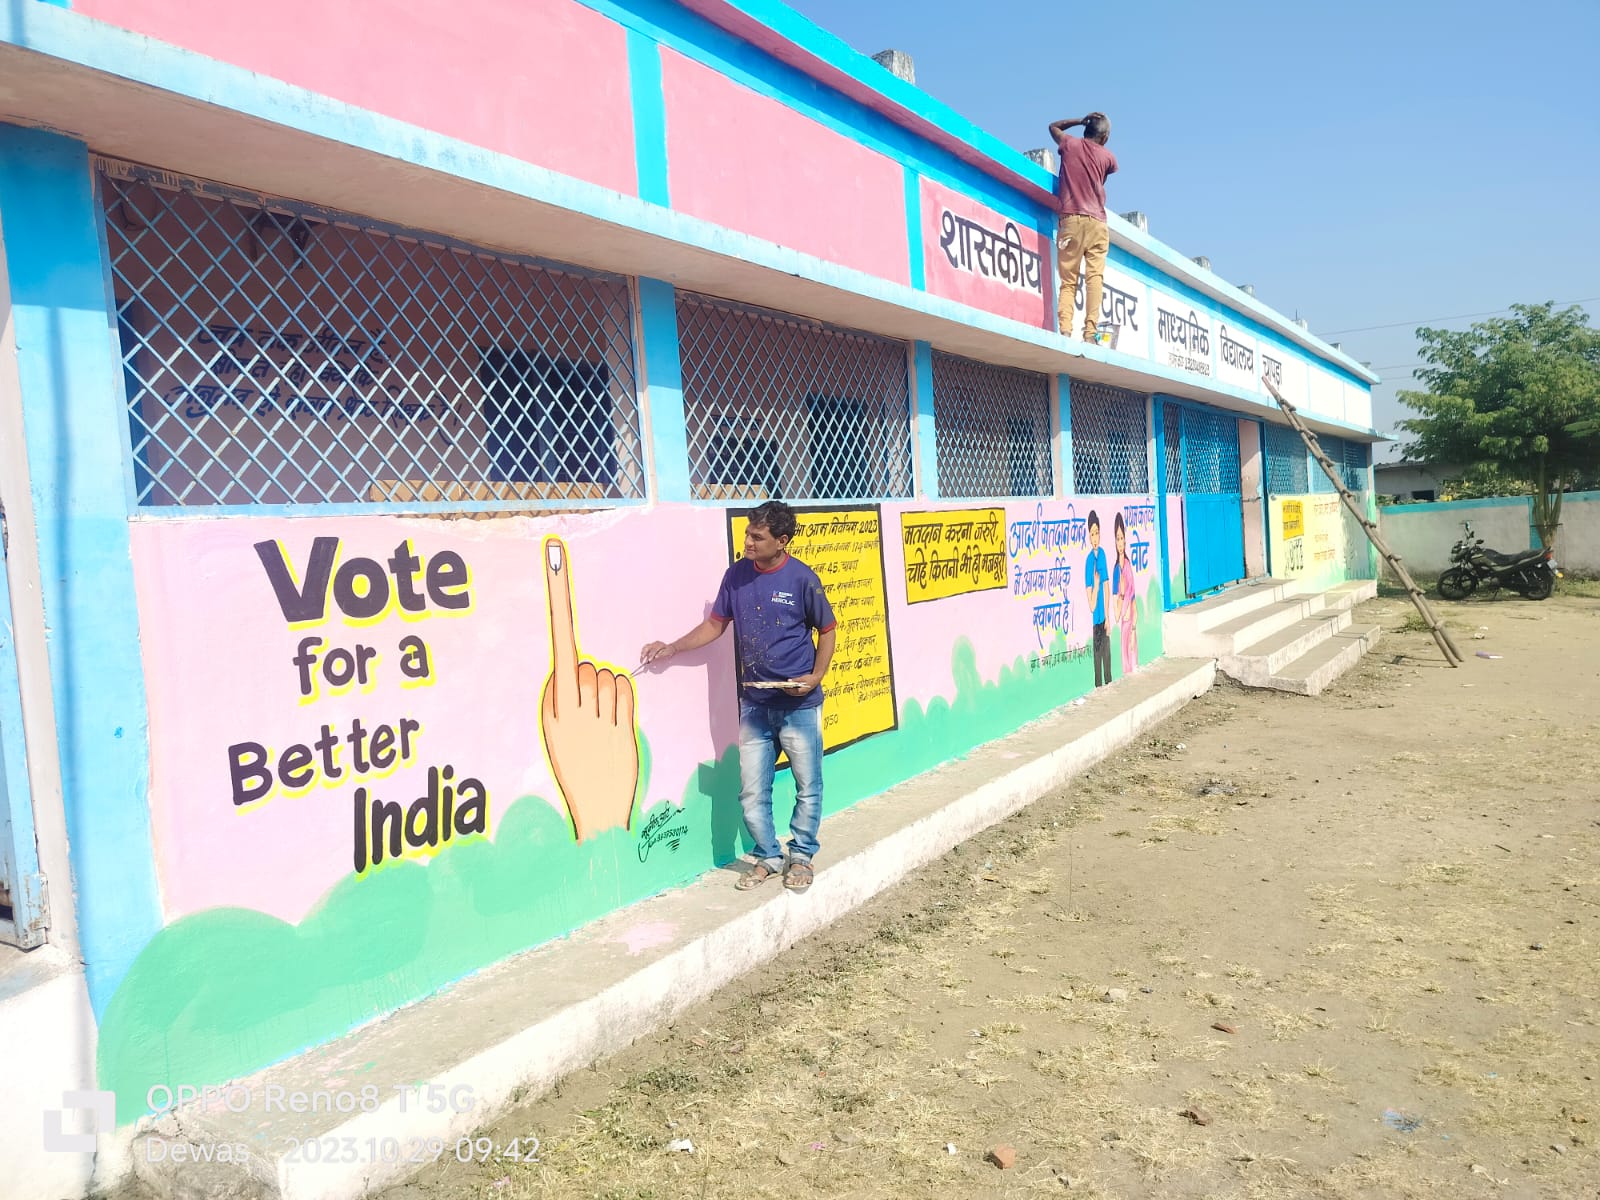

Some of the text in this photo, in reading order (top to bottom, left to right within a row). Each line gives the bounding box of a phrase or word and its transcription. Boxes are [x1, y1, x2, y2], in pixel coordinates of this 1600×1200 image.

[940, 210, 1042, 294] शासकीय
[1158, 306, 1210, 357] माध्यमिक
[1220, 324, 1255, 375] विद्यालय
[904, 523, 944, 550] मतदान
[944, 521, 974, 543] करना
[1009, 502, 1042, 558] आदर्श
[1041, 519, 1071, 553] मतदान
[1130, 530, 1150, 573] वोट
[253, 536, 471, 622] Vote
[907, 547, 928, 589] चाहे
[929, 546, 960, 581] कितनी
[960, 545, 972, 574] भी
[1022, 569, 1048, 595] आपका
[1033, 602, 1062, 649] स्वागत
[292, 634, 431, 696] for a
[227, 717, 421, 806] Better
[353, 764, 487, 874] India
